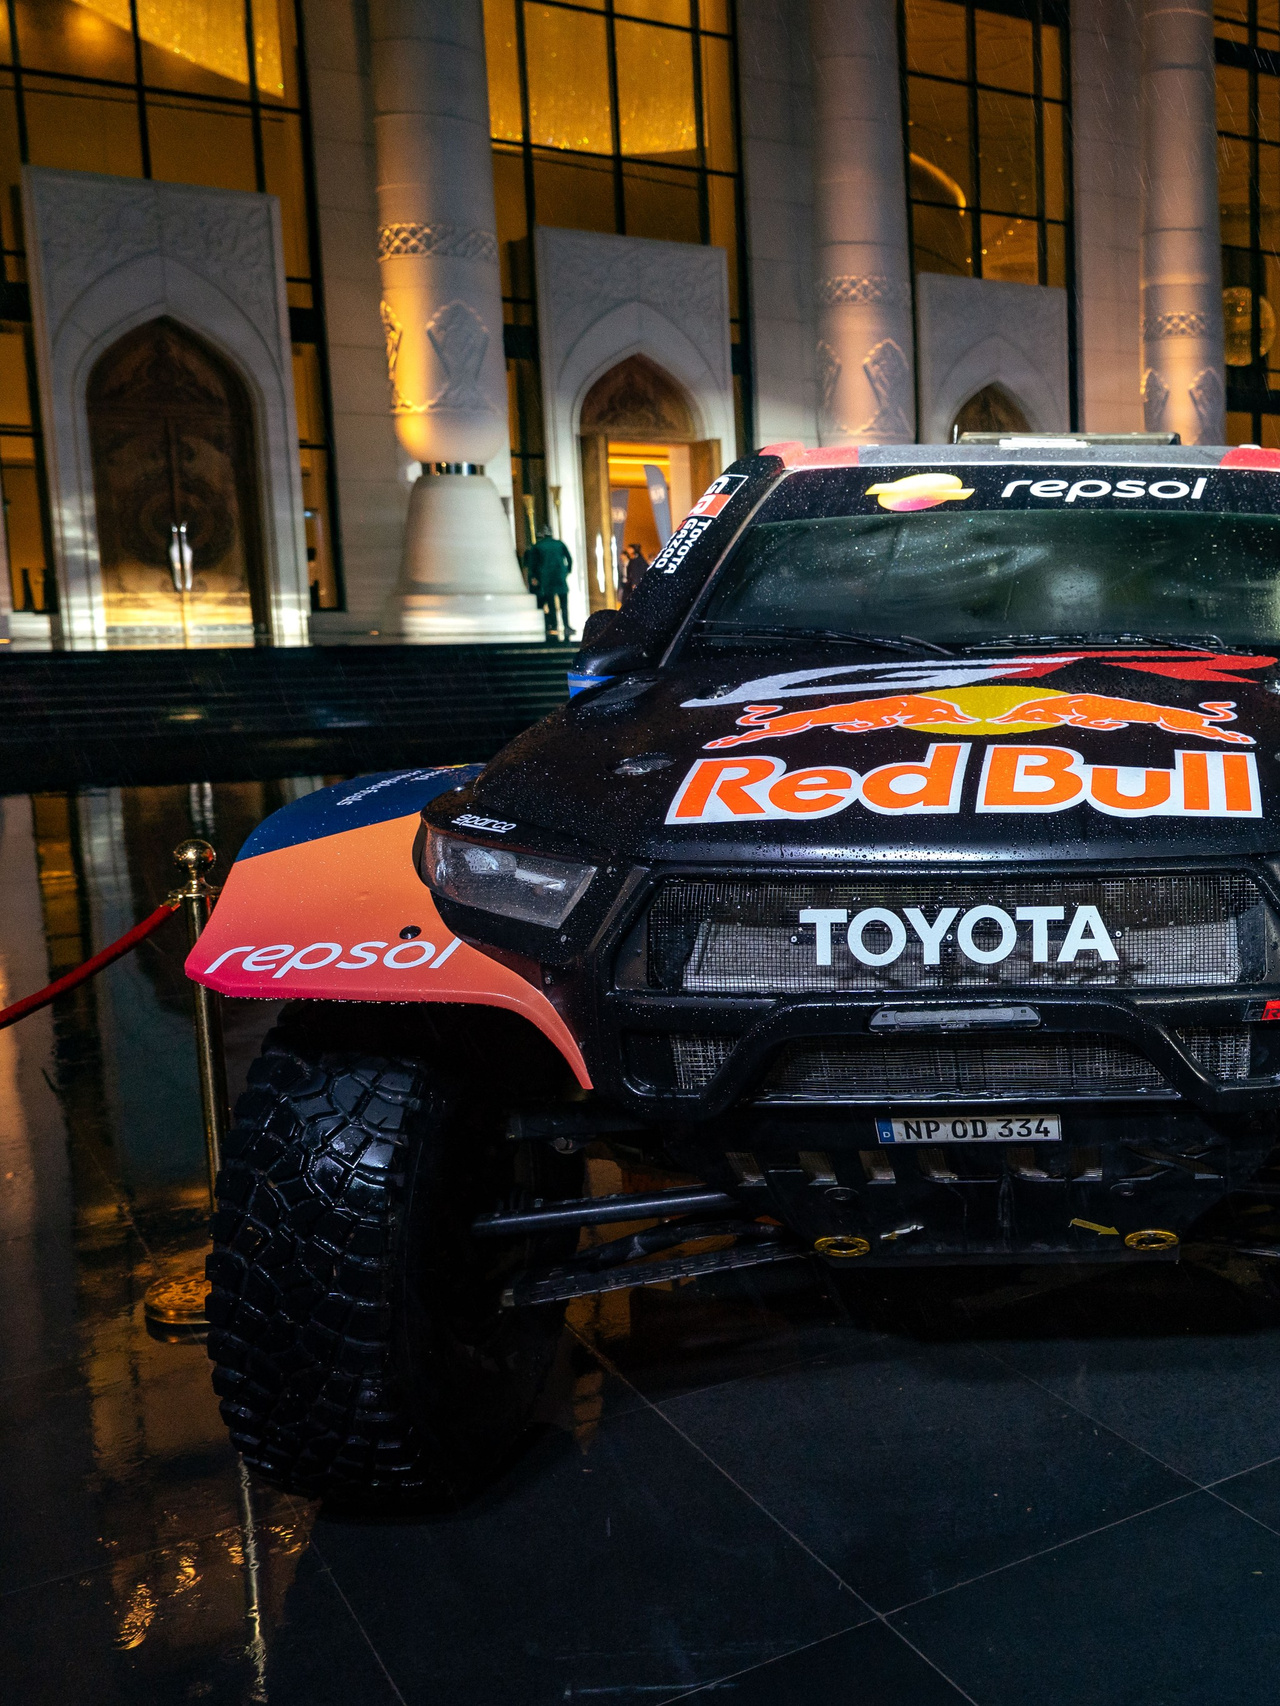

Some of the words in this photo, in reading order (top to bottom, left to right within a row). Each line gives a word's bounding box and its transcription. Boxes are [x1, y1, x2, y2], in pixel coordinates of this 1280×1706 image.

[1001, 477, 1207, 502] repsol
[655, 518, 698, 568] GAZOO
[664, 519, 712, 573] TOYOTA
[665, 743, 968, 824] Red
[976, 744, 1263, 818] Bull
[454, 813, 517, 832] sparco
[204, 937, 463, 979] repsol
[799, 904, 1119, 966] TOYOTA
[903, 1120, 940, 1140] NP
[997, 1118, 1051, 1138] 334
